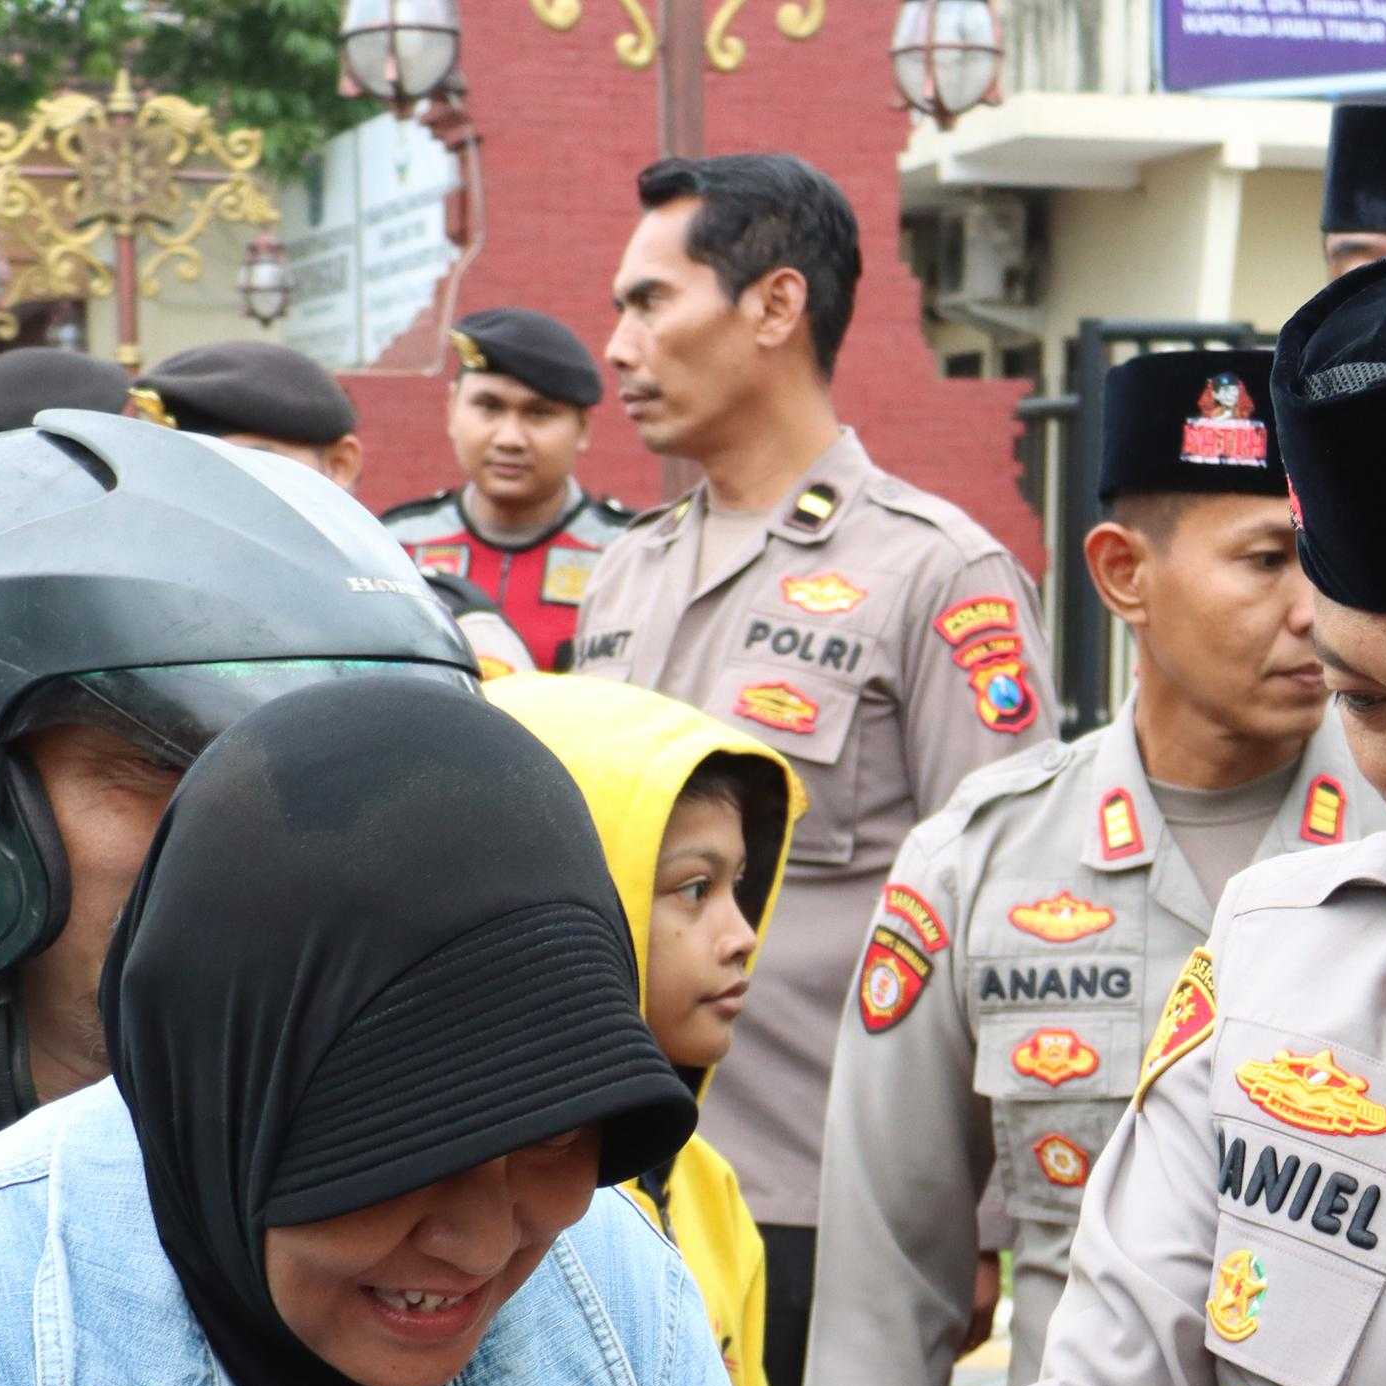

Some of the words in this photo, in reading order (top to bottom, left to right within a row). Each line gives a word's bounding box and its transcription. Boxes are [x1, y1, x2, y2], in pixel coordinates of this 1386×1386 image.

[745, 619, 864, 674] POLRI
[980, 965, 1133, 1001] ANANG
[1216, 1125, 1382, 1251] ANIEL
